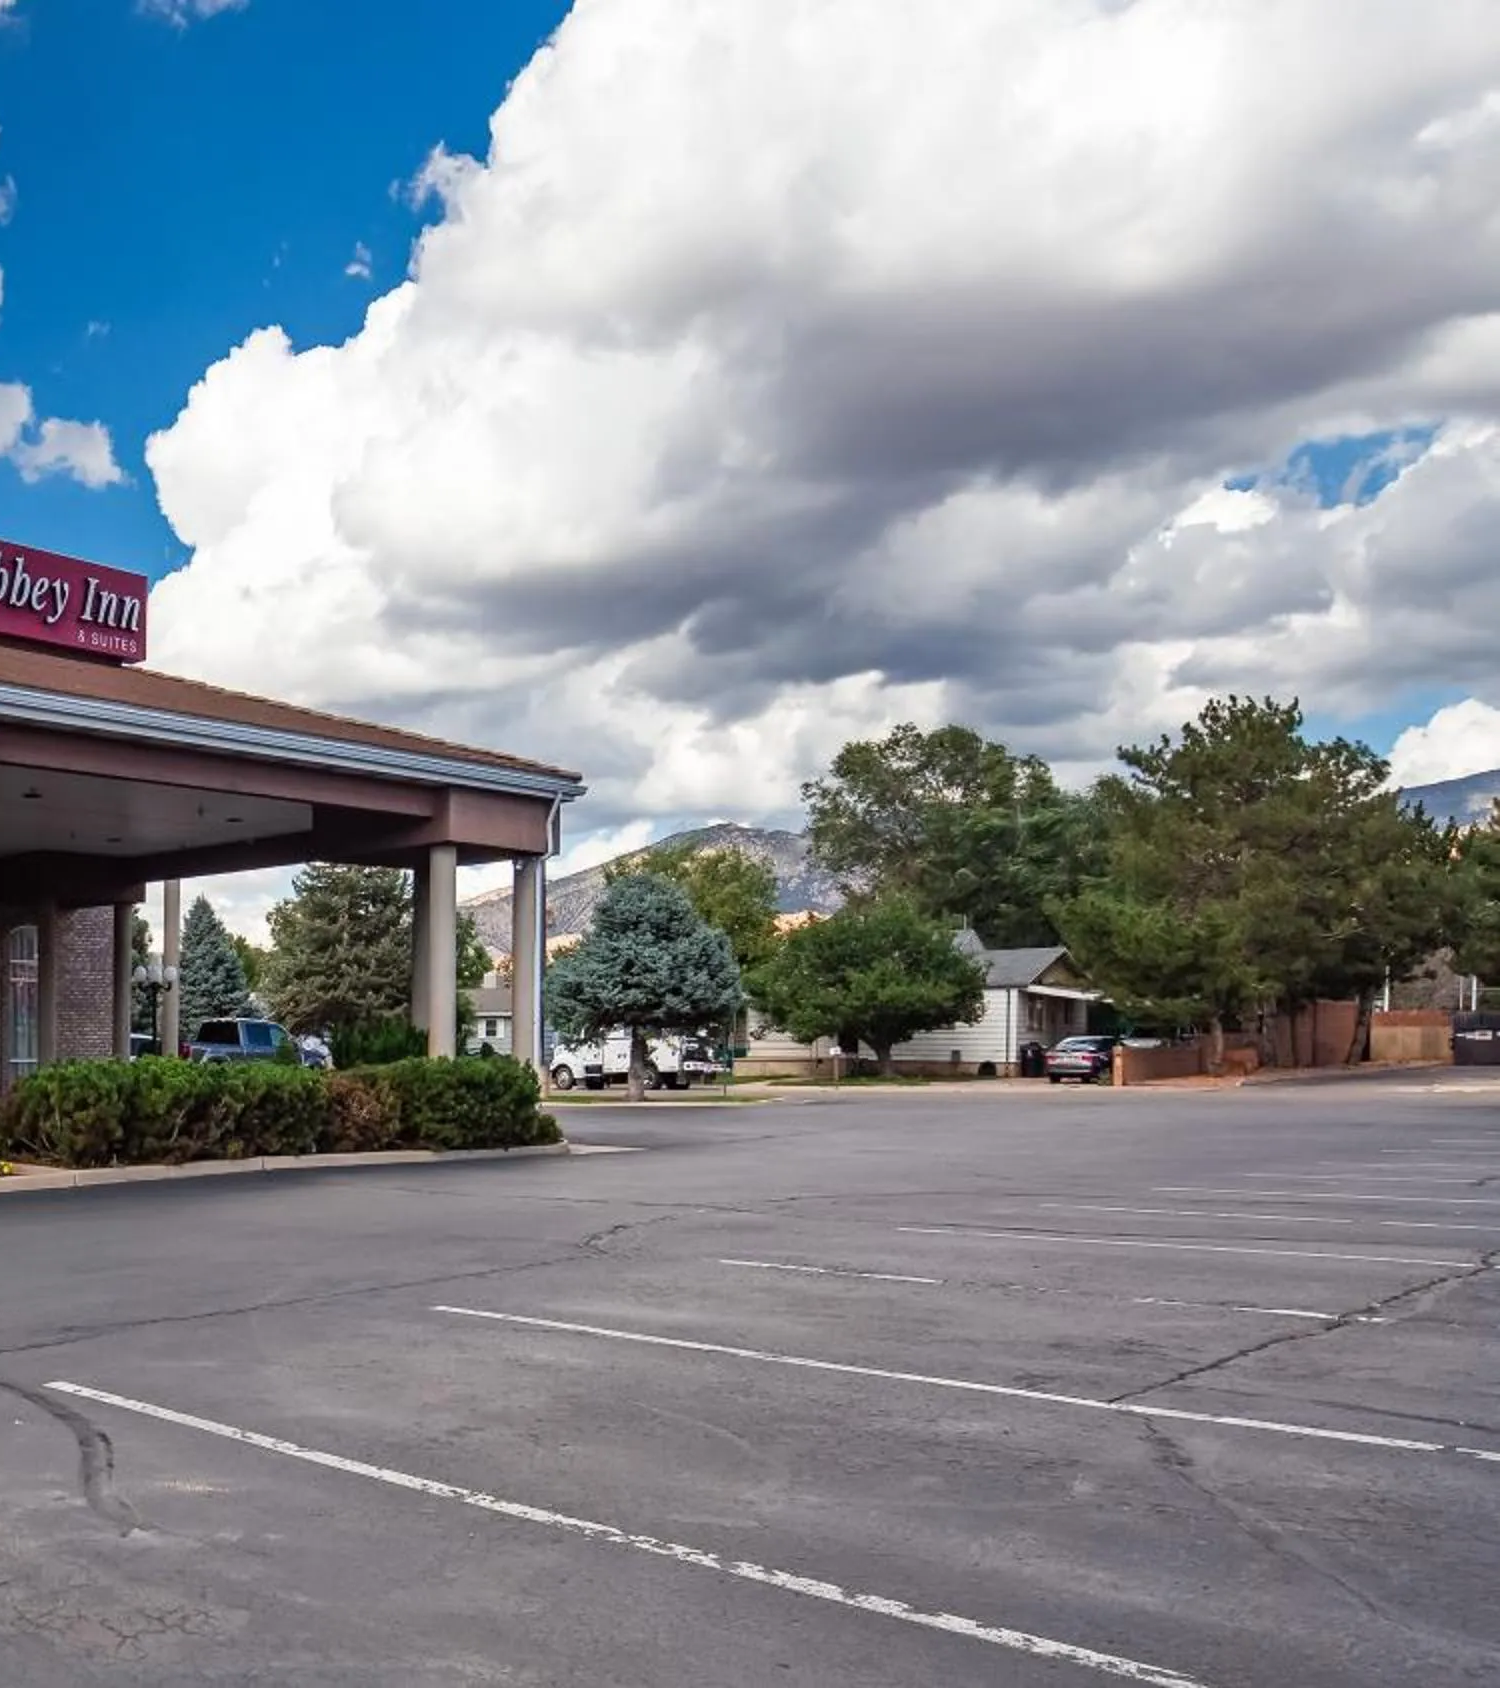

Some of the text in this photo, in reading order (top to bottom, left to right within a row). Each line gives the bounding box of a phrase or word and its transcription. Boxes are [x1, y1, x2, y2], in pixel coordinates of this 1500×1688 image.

[80, 577, 140, 631] Inn
[77, 629, 137, 653] & SUITES
